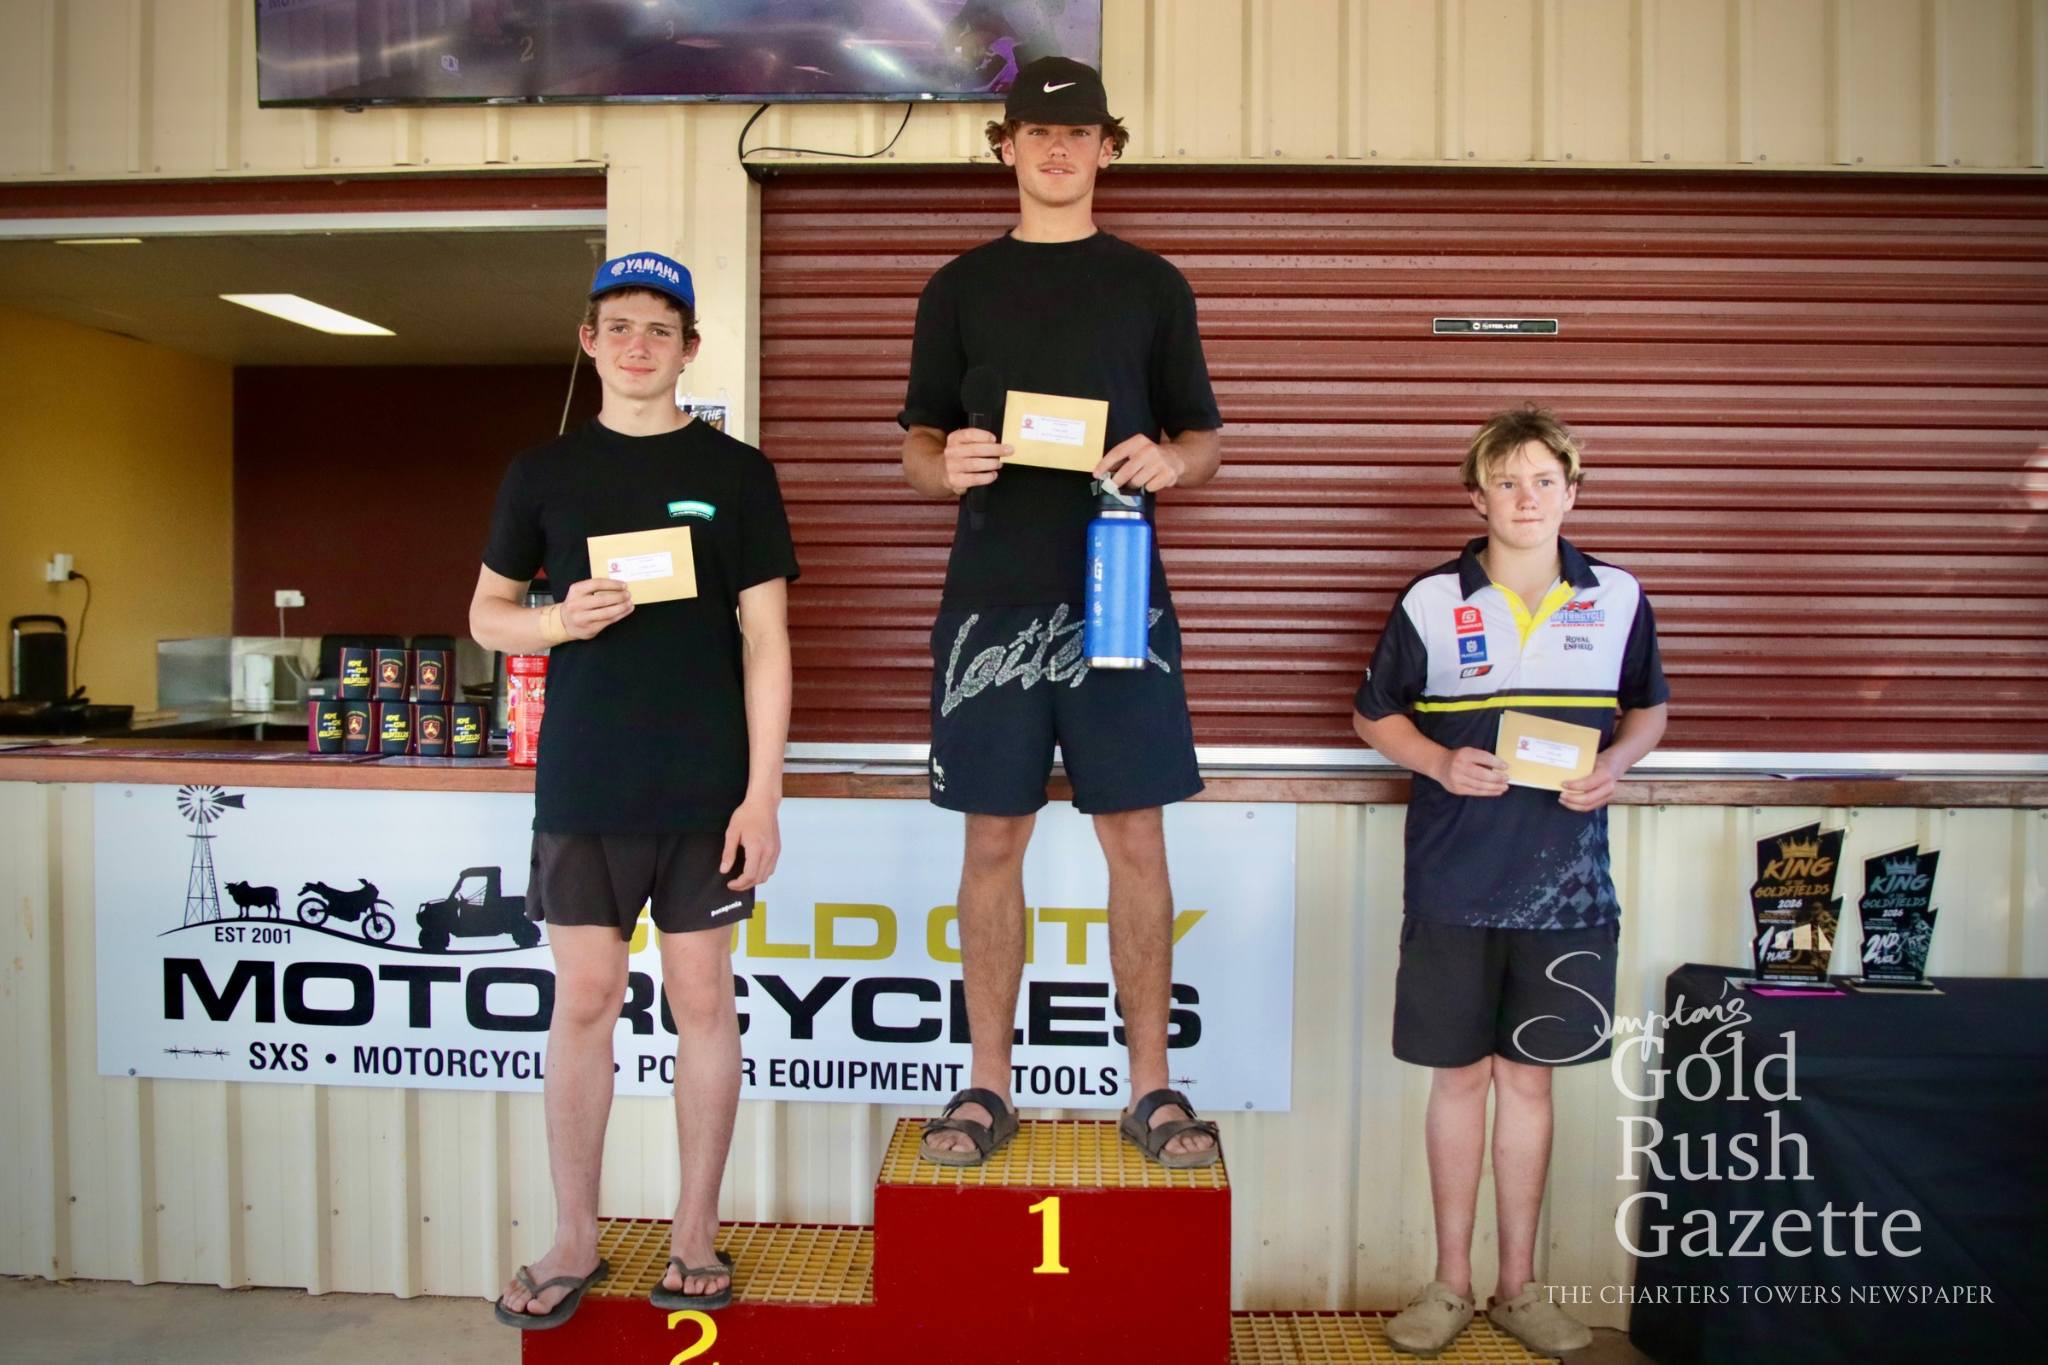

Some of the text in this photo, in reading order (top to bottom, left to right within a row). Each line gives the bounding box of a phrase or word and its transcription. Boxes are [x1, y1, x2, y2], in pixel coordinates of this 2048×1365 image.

[625, 258, 679, 283] YAMAHA
[701, 409, 722, 421] THE
[1550, 610, 1604, 622] MOTORCYCLE
[1763, 857, 1834, 880] KING
[1754, 884, 1830, 898] GOLDFIELDS
[1869, 874, 1931, 894] KING
[710, 900, 742, 917] patagonia
[1777, 899, 1803, 909] 2026
[1862, 897, 1926, 909] GOLDFIELDS
[1882, 909, 1904, 917] 2026
[215, 927, 292, 944] EST 2001
[1766, 950, 1791, 962] PLACE
[1863, 932, 1900, 963] 2ND
[249, 1042, 309, 1072] SXS
[769, 1058, 964, 1092] EQUIPMENT
[1011, 1065, 1118, 1096] TOOLS
[1028, 1196, 1070, 1274] 1
[667, 1310, 720, 1365] 2
